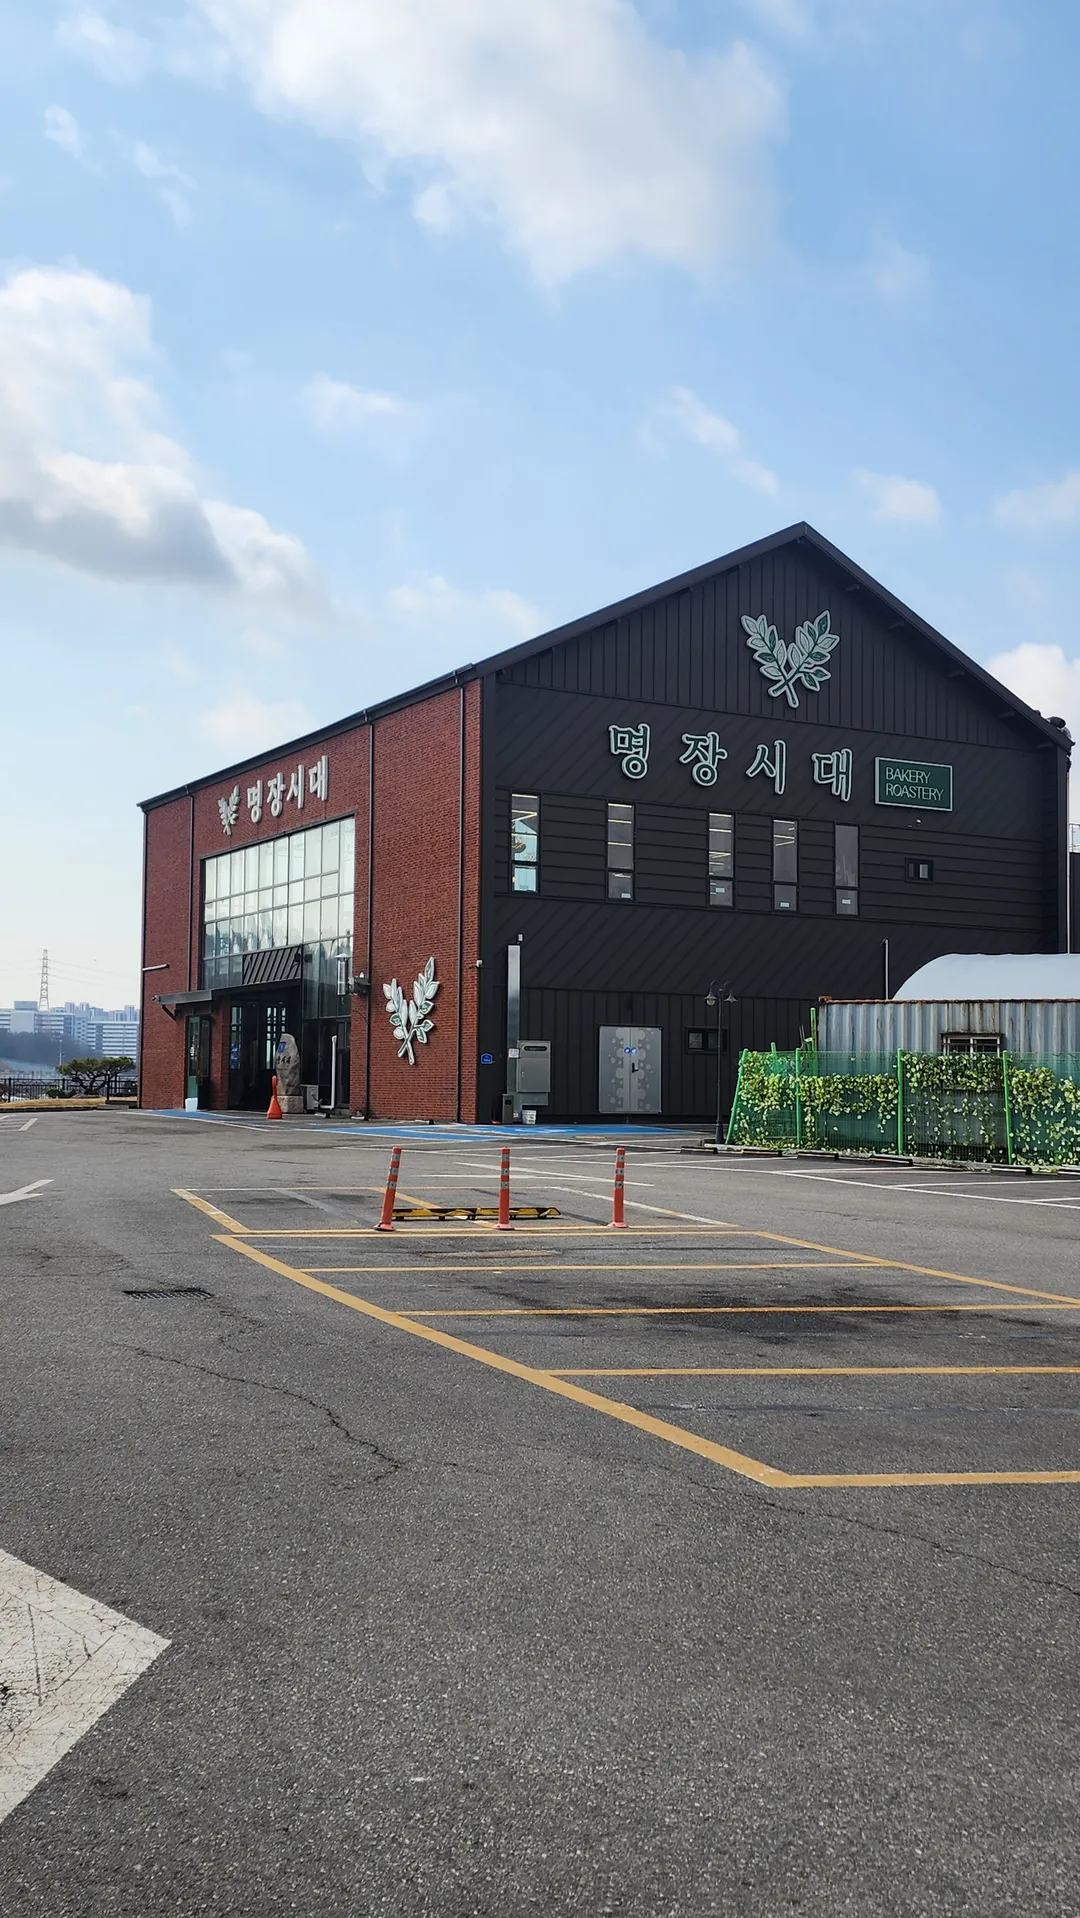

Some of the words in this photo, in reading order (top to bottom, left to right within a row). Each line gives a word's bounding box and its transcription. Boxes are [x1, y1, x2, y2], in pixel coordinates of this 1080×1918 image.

[608, 723, 853, 802] 명장시대
[885, 766, 932, 784] BAKERY
[246, 755, 328, 823] 명장시대
[885, 783, 944, 801] ROASTERY
